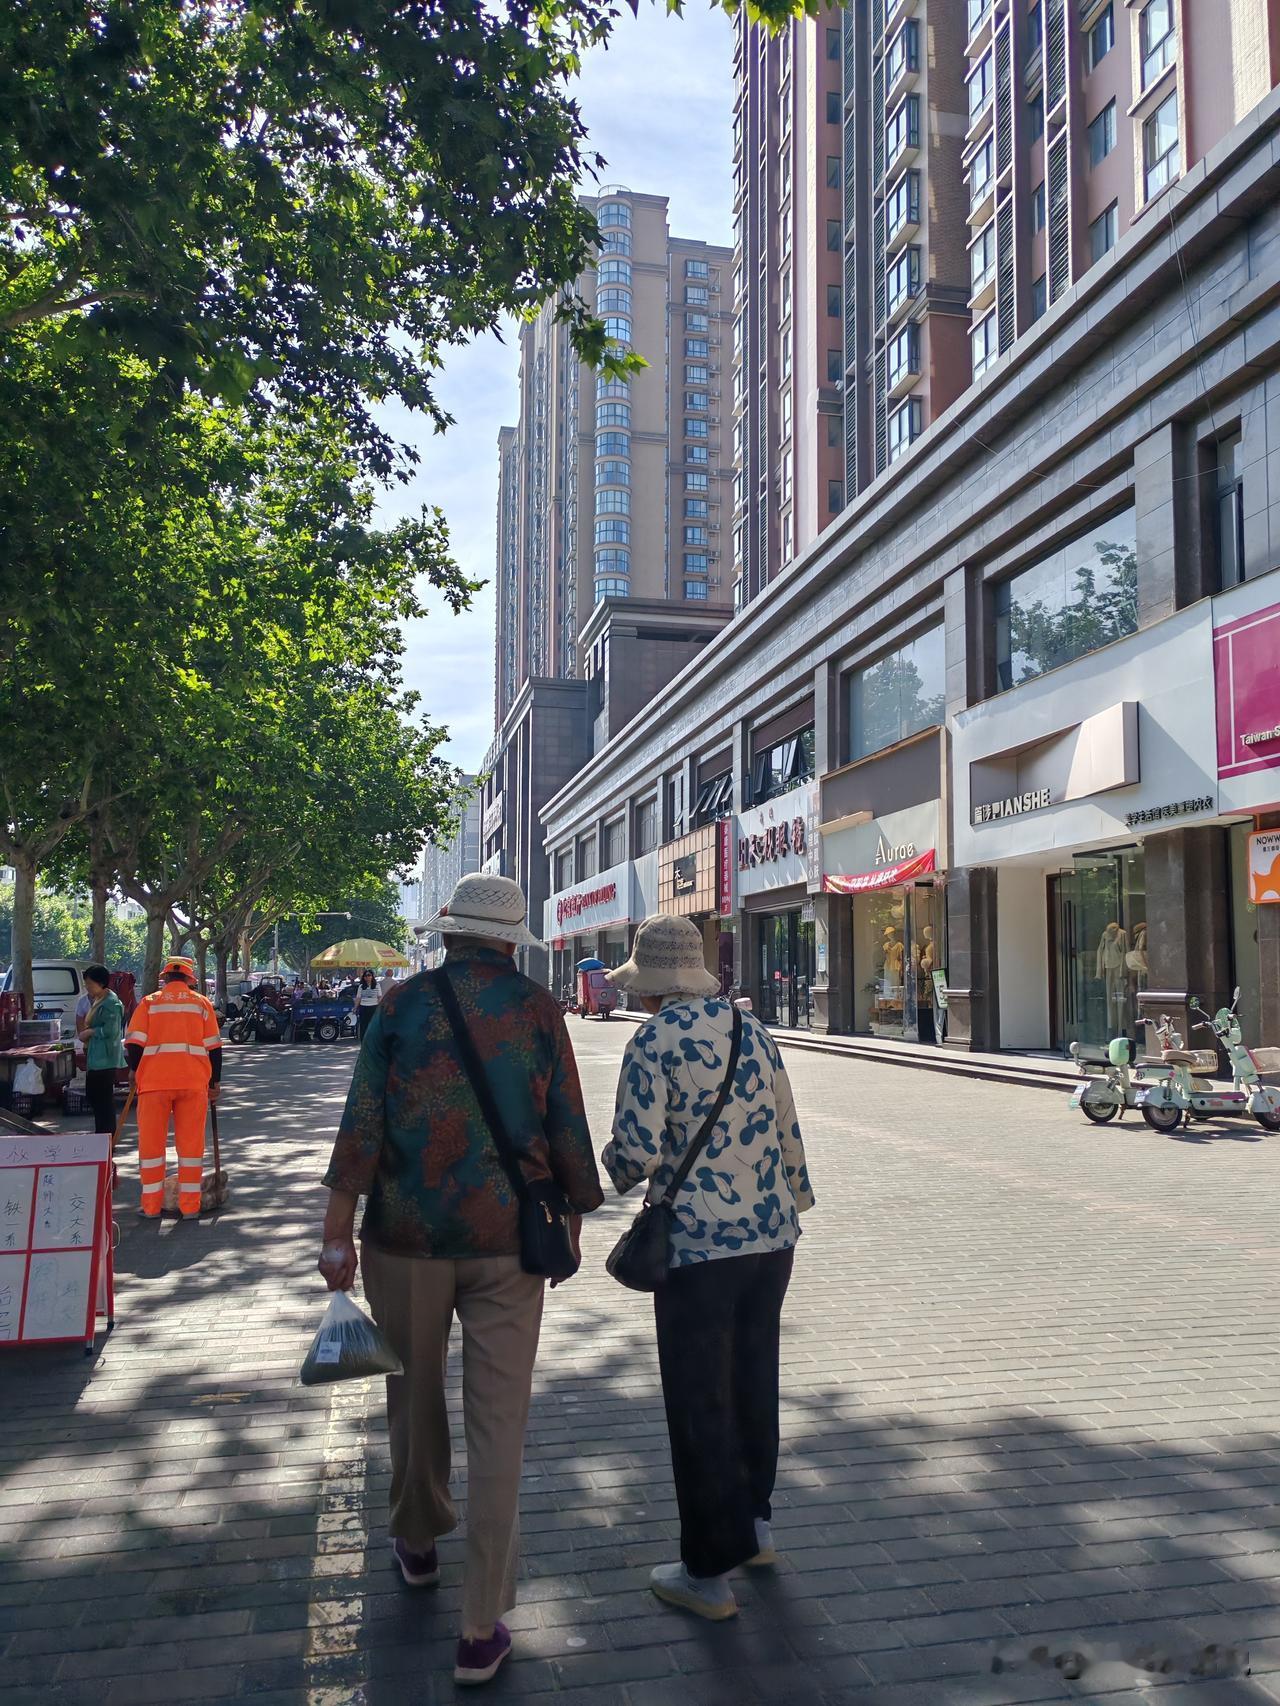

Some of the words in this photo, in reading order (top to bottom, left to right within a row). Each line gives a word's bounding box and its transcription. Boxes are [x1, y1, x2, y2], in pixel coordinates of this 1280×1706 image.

[1240, 730, 1275, 745] Taiwan
[70, 1193, 86, 1244] 交大系
